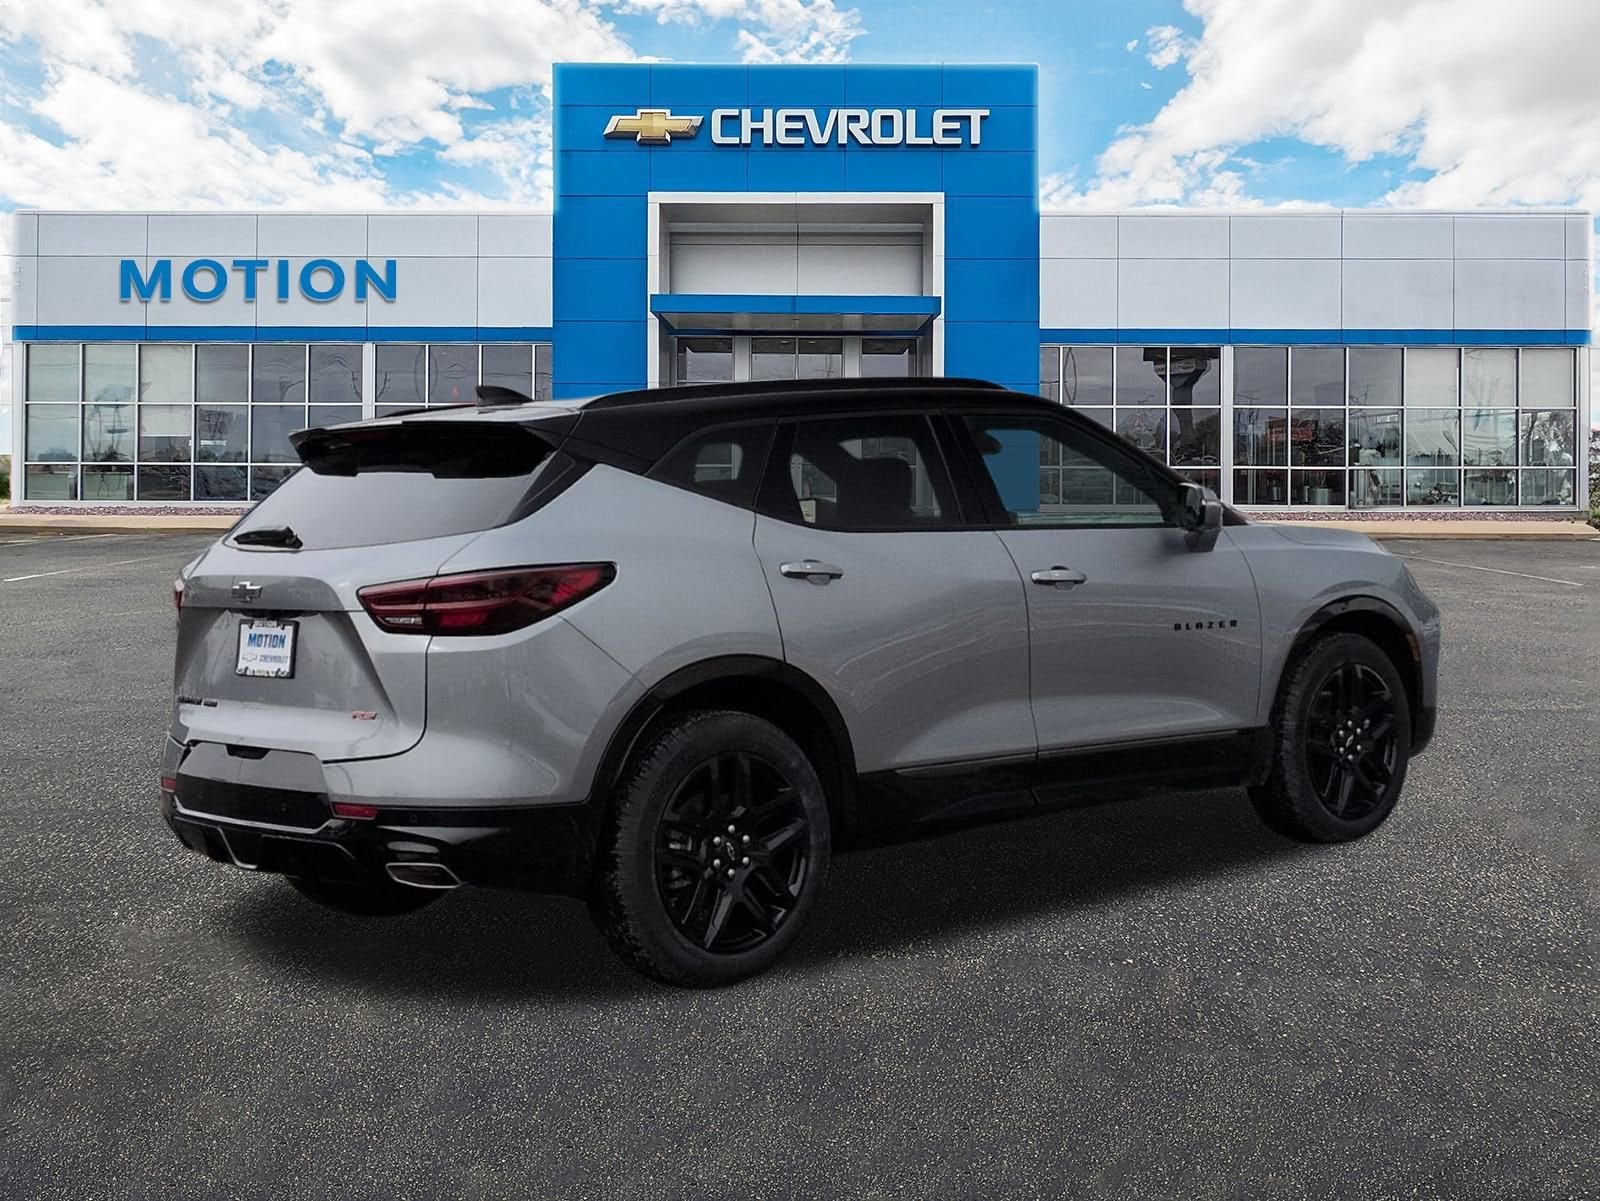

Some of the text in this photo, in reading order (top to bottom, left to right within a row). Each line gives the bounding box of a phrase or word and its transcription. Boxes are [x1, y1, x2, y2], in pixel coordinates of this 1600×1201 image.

[711, 108, 990, 145] CHEVROLET
[119, 258, 397, 302] MOTION
[1174, 619, 1238, 631] BLAZER
[247, 633, 287, 648] MOTION
